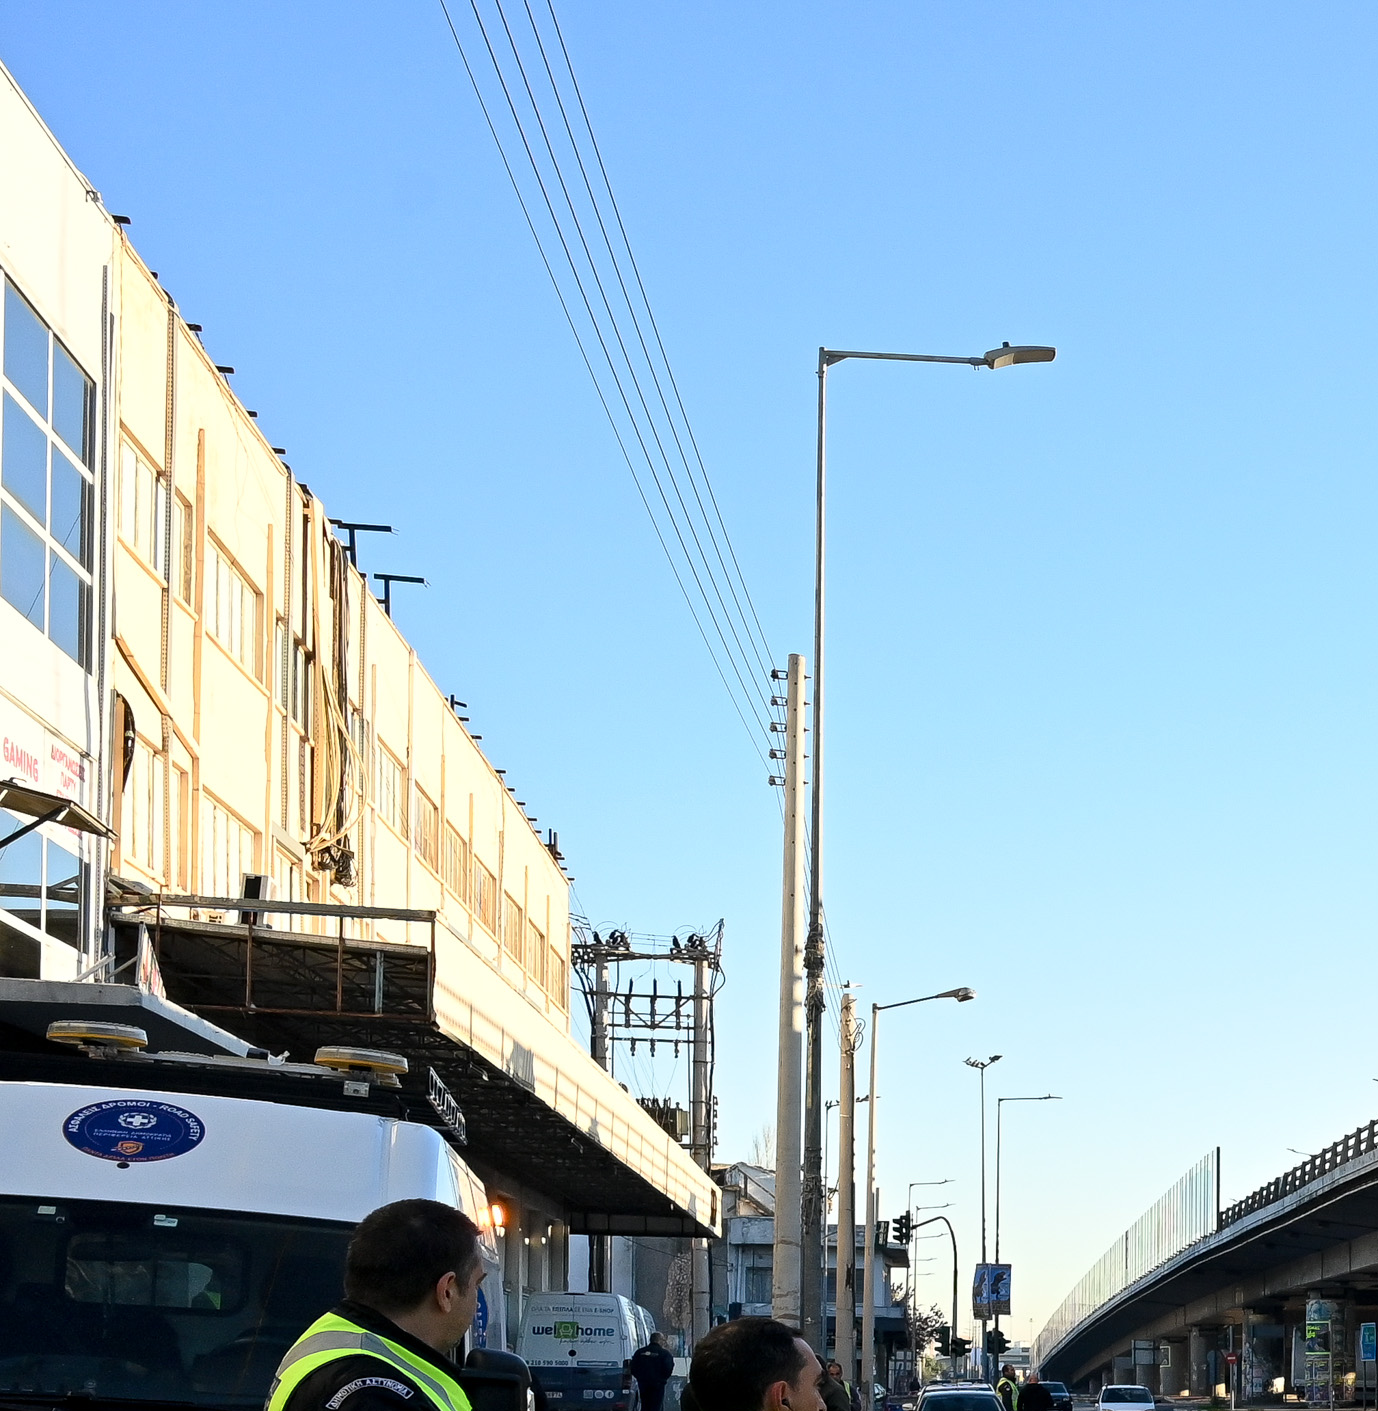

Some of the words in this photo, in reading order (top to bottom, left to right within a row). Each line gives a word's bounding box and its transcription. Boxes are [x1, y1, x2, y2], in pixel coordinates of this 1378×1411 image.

[3, 737, 39, 782] GAMING
[68, 1104, 102, 1133] ΑΣΦΑΛΕΙΣ
[102, 1101, 150, 1109] ΔΡΟΜΟΙ
[159, 1104, 189, 1119] ROAD
[185, 1115, 201, 1141] SAFETY
[330, 1381, 363, 1408] ΔΗΜΟΤΙΚΗ
